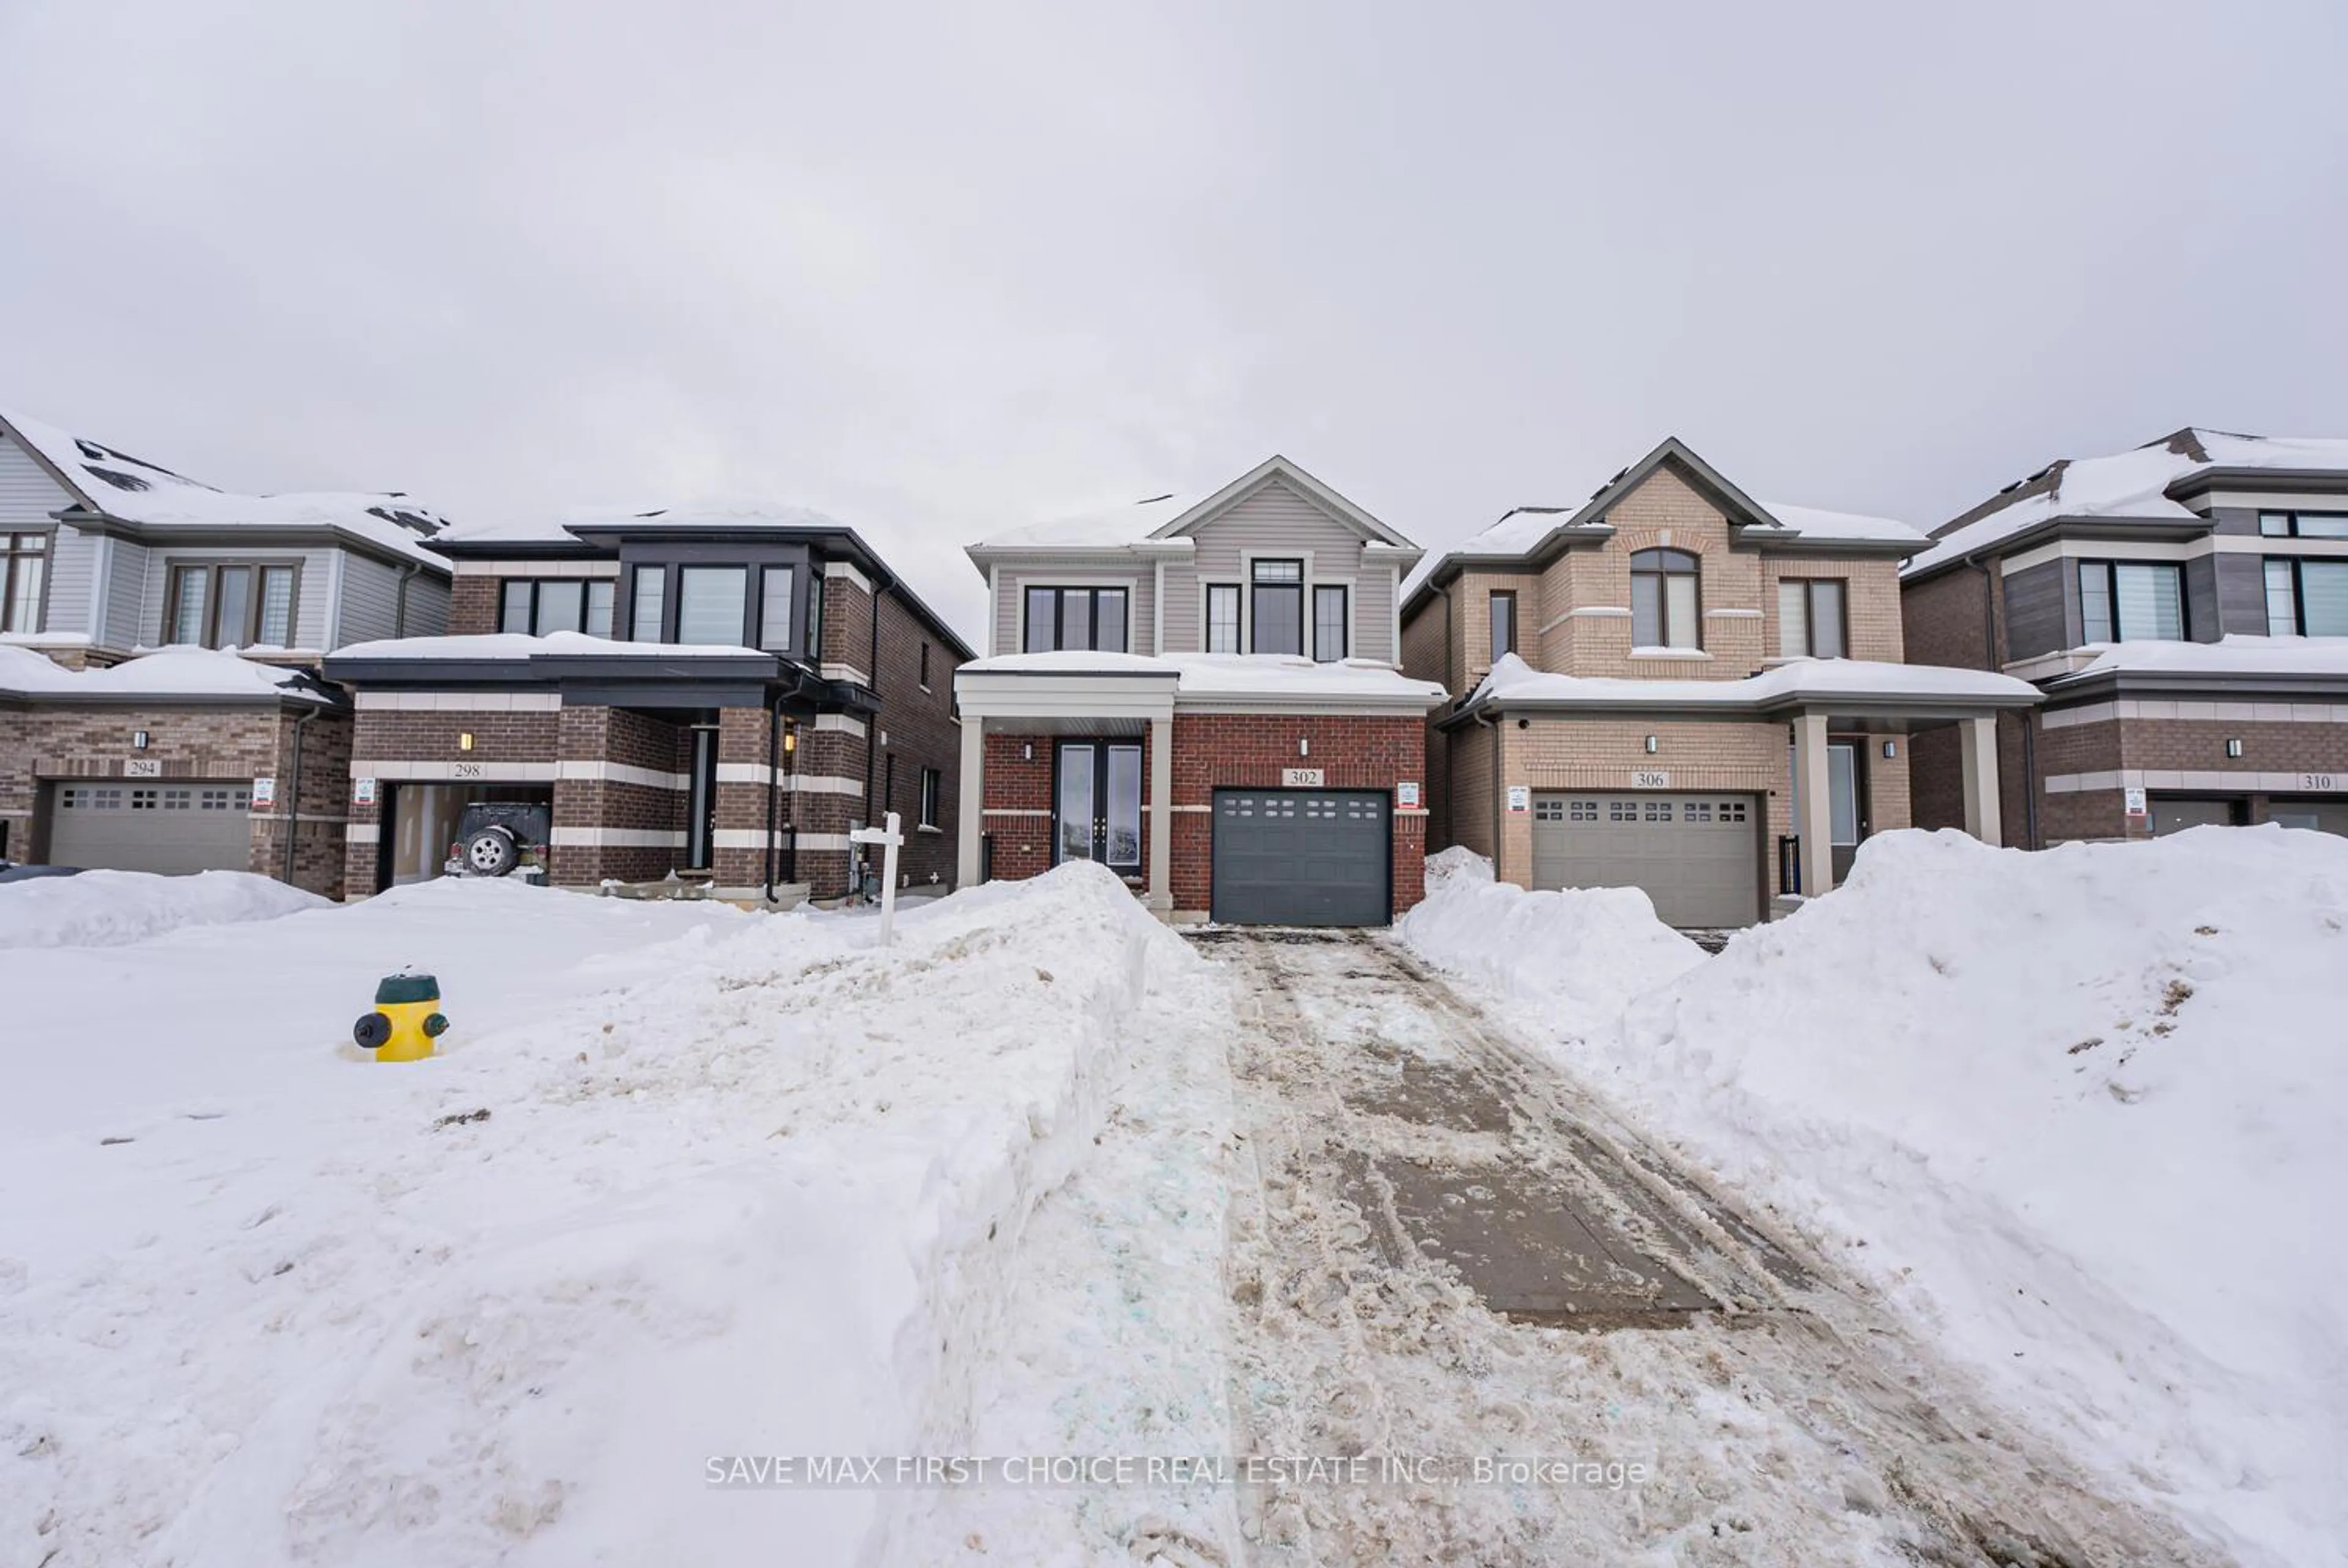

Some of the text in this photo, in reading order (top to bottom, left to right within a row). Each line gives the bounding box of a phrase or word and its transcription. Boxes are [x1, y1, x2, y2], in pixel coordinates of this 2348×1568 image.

[130, 761, 155, 775] 294
[454, 764, 480, 777] 298
[1291, 771, 1317, 785] 302
[1638, 773, 1663, 787] 306
[2305, 775, 2330, 789] 310
